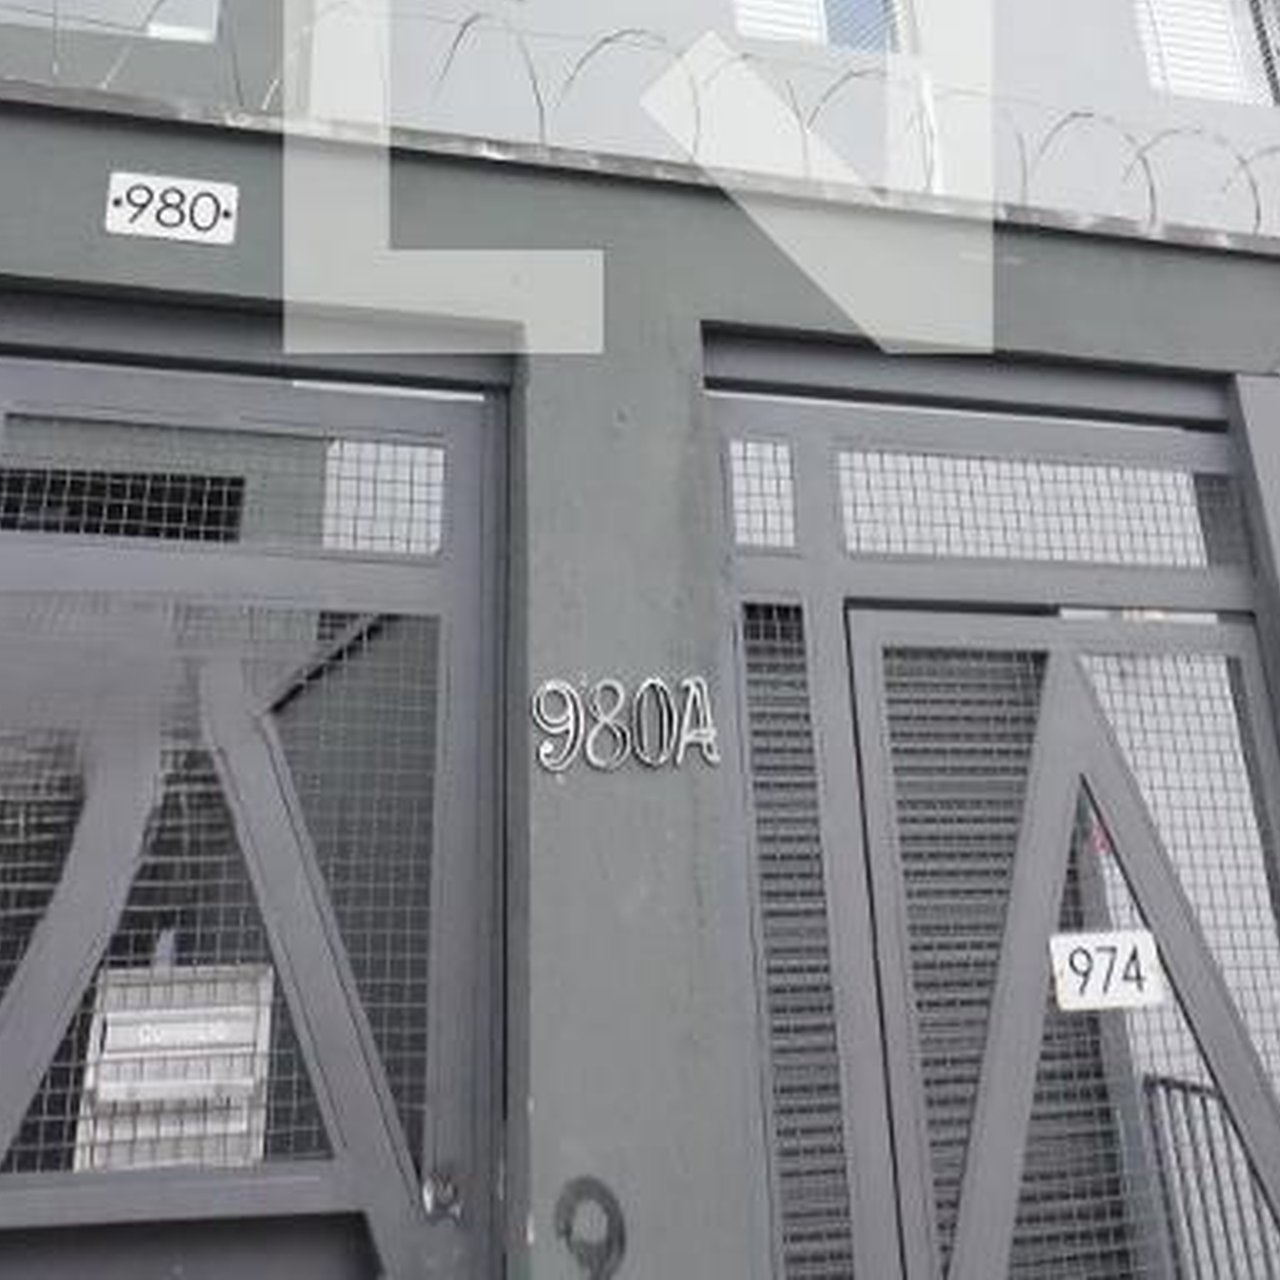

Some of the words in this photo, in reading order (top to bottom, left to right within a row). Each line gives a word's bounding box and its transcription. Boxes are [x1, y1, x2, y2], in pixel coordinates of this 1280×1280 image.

[126, 184, 221, 232] 980
[532, 676, 721, 771] 980A
[1069, 946, 1146, 995] 974
